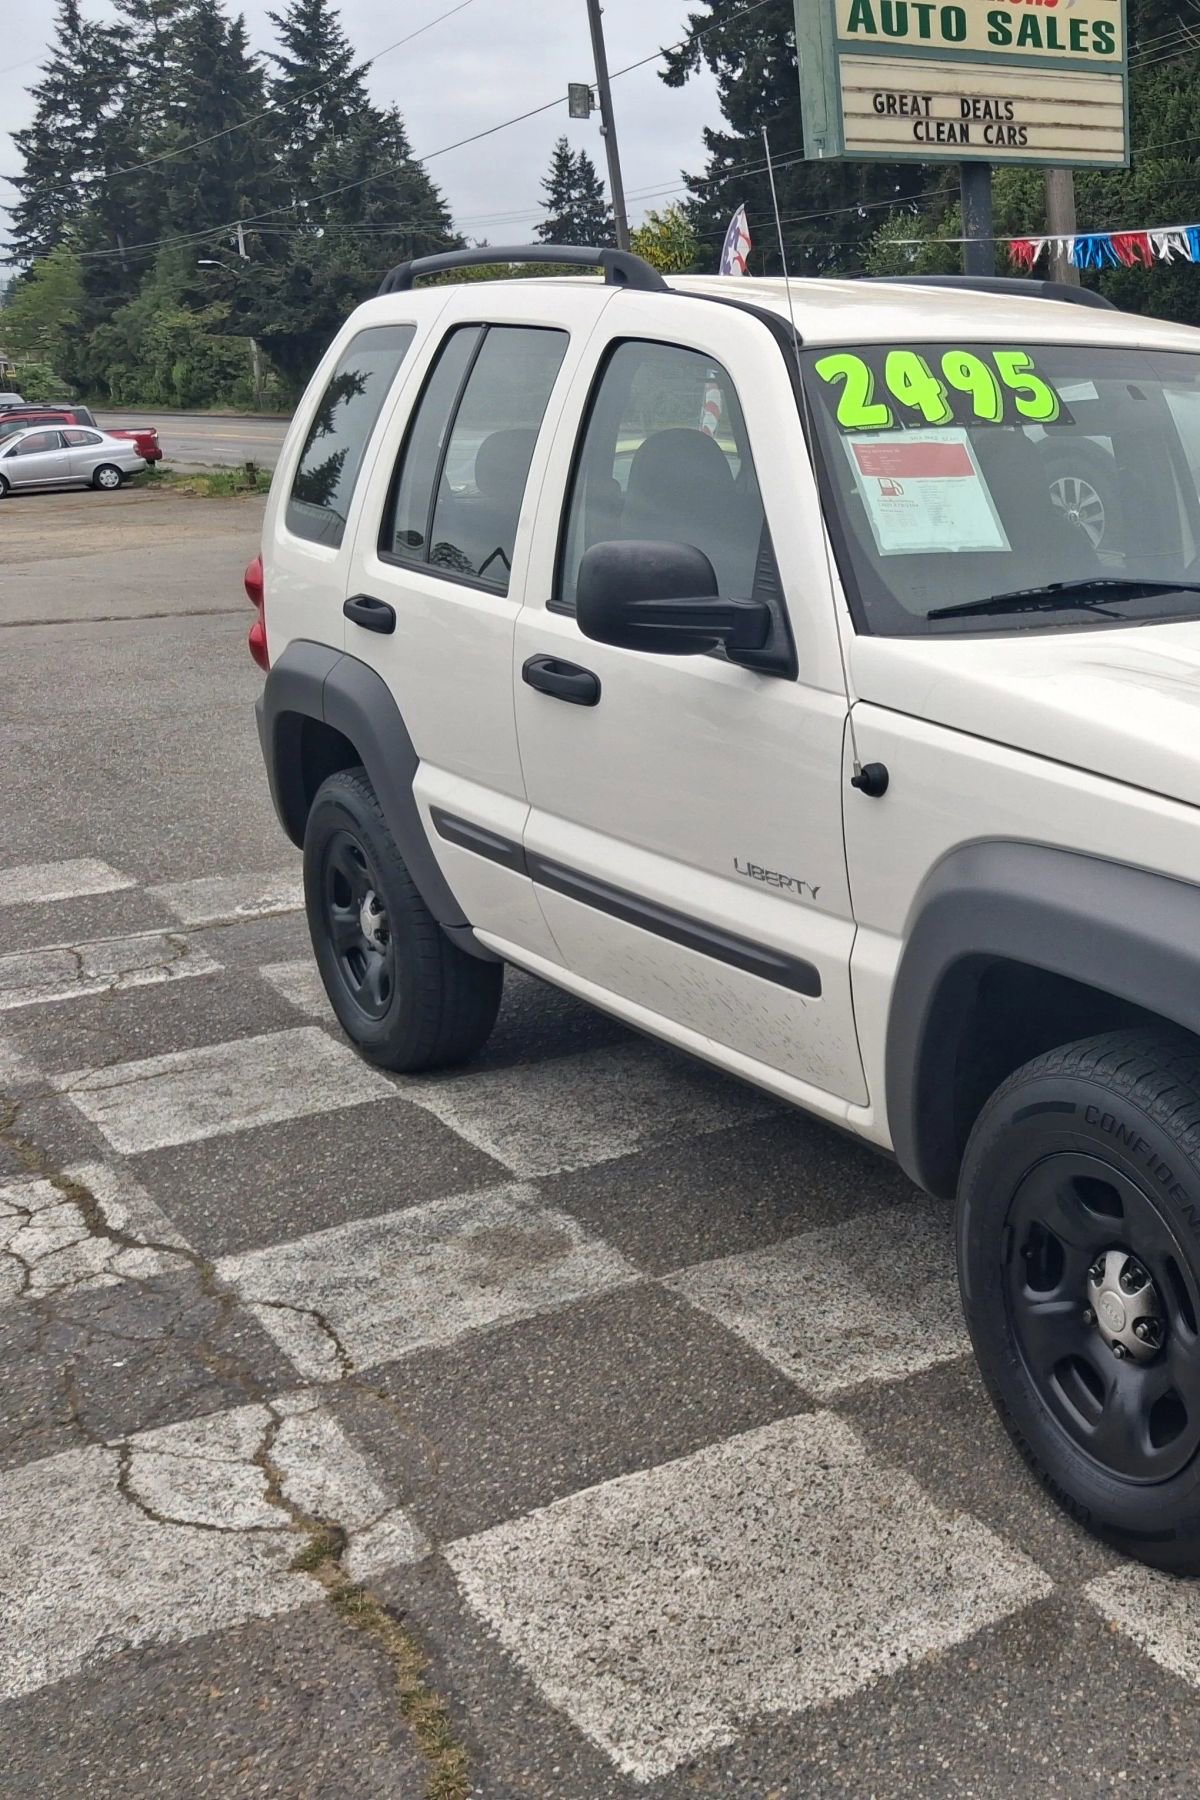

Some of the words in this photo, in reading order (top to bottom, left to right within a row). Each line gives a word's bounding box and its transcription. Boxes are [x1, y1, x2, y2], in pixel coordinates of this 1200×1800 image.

[846, 0, 967, 42] AUTO
[987, 10, 1116, 54] SALES
[872, 93, 932, 117] GREAT
[960, 98, 1015, 121] DEALS
[913, 120, 970, 143] CLEAN
[983, 124, 1029, 146] CARS
[814, 350, 1060, 430] 2495
[733, 857, 821, 900] LIBERTY
